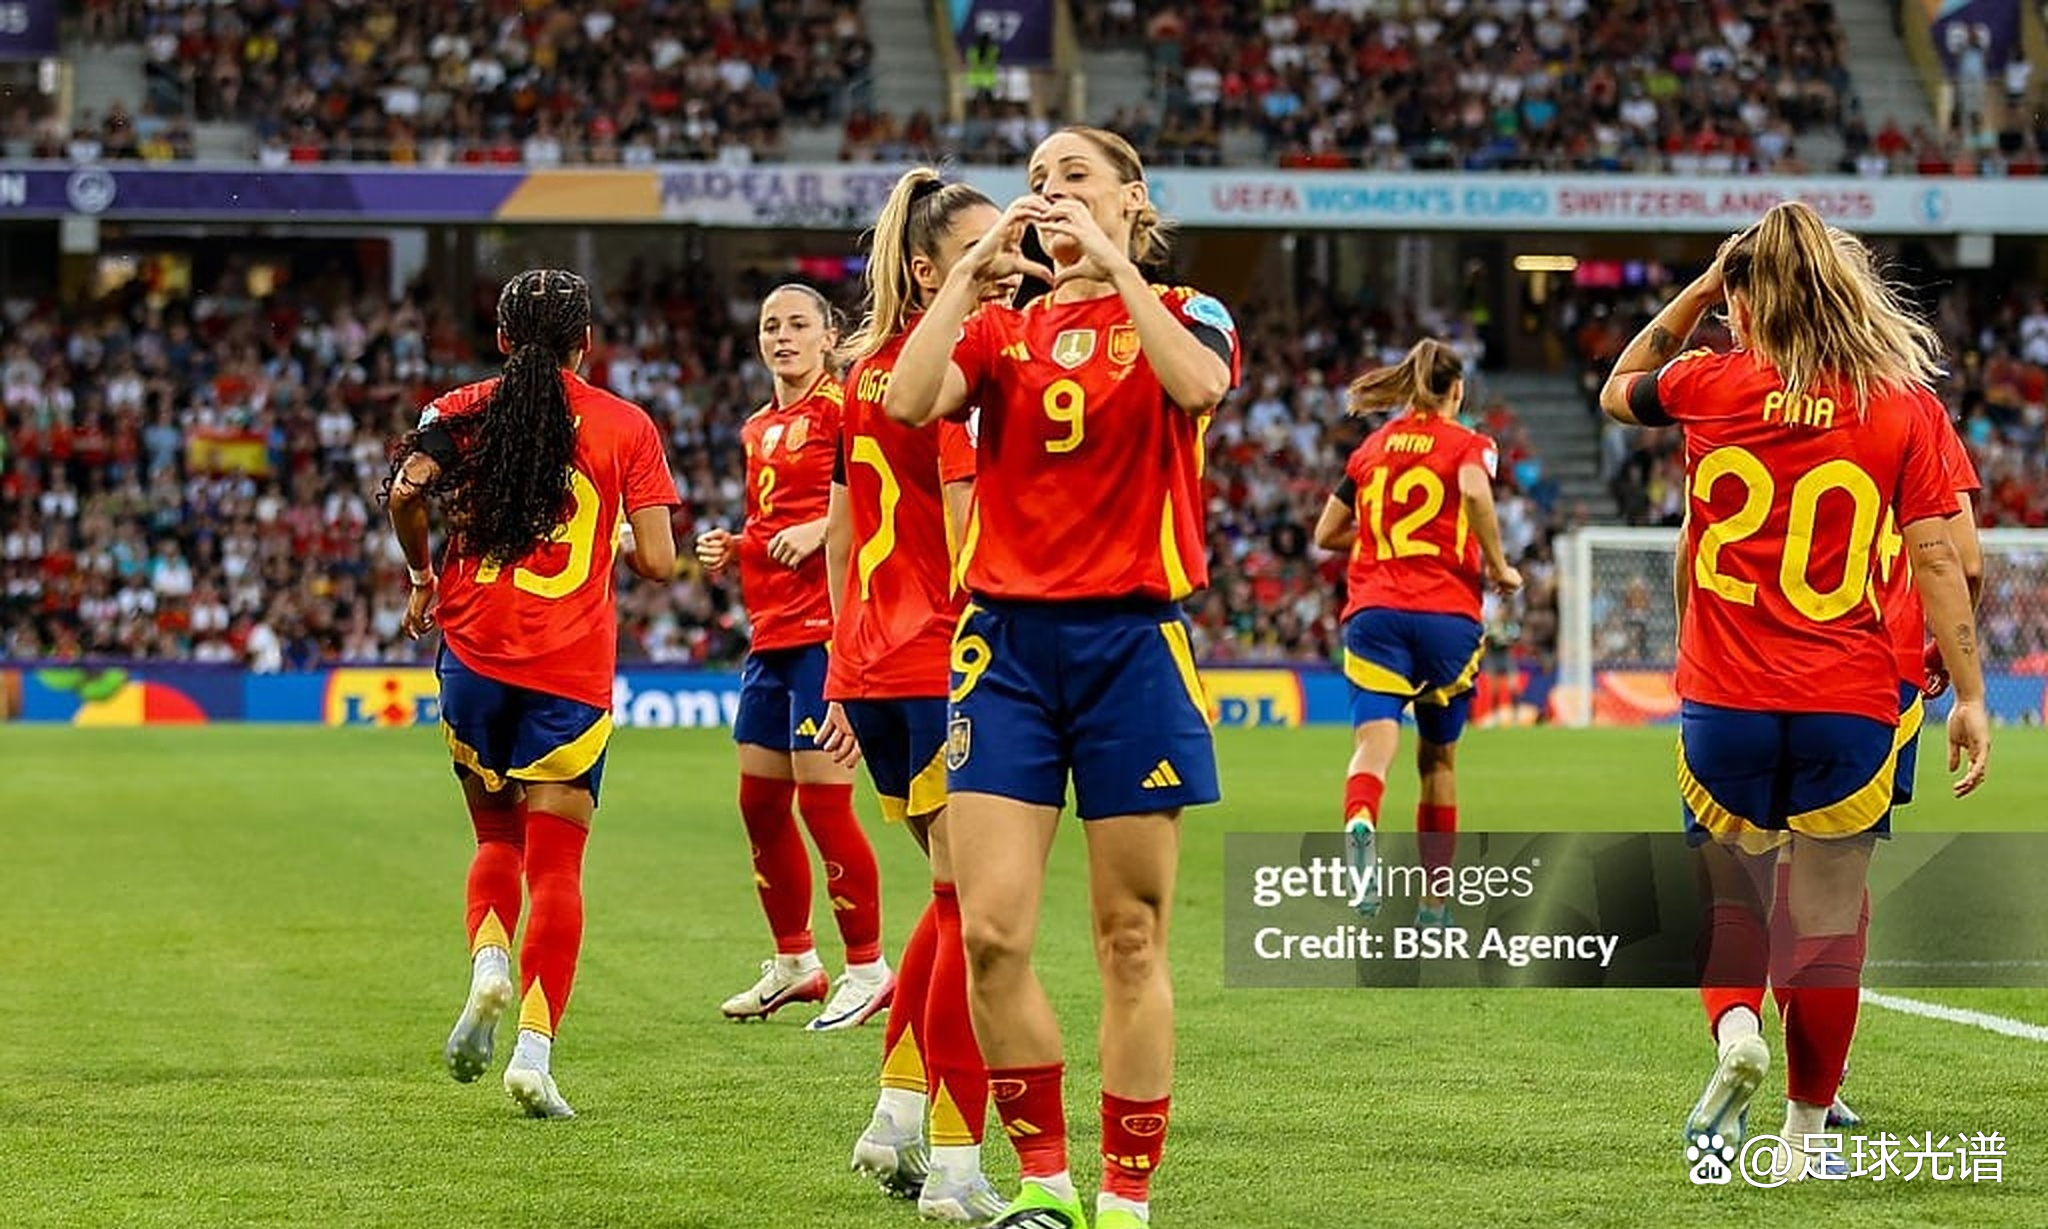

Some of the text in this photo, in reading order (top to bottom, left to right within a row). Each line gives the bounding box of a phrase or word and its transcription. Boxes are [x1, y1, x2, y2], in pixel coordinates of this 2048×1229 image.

[1211, 183, 1297, 213] UEFA
[1303, 185, 1454, 214] WOMEN'S
[1463, 187, 1549, 216] EURO
[1557, 188, 1783, 218] SWITZERLAND
[1043, 379, 1085, 453] 9
[1384, 432, 1435, 454] PATRI
[758, 465, 776, 517] 2
[1361, 465, 1445, 561] 12
[474, 464, 600, 599] 9
[1693, 445, 1881, 622] 20
[951, 635, 992, 703] 9
